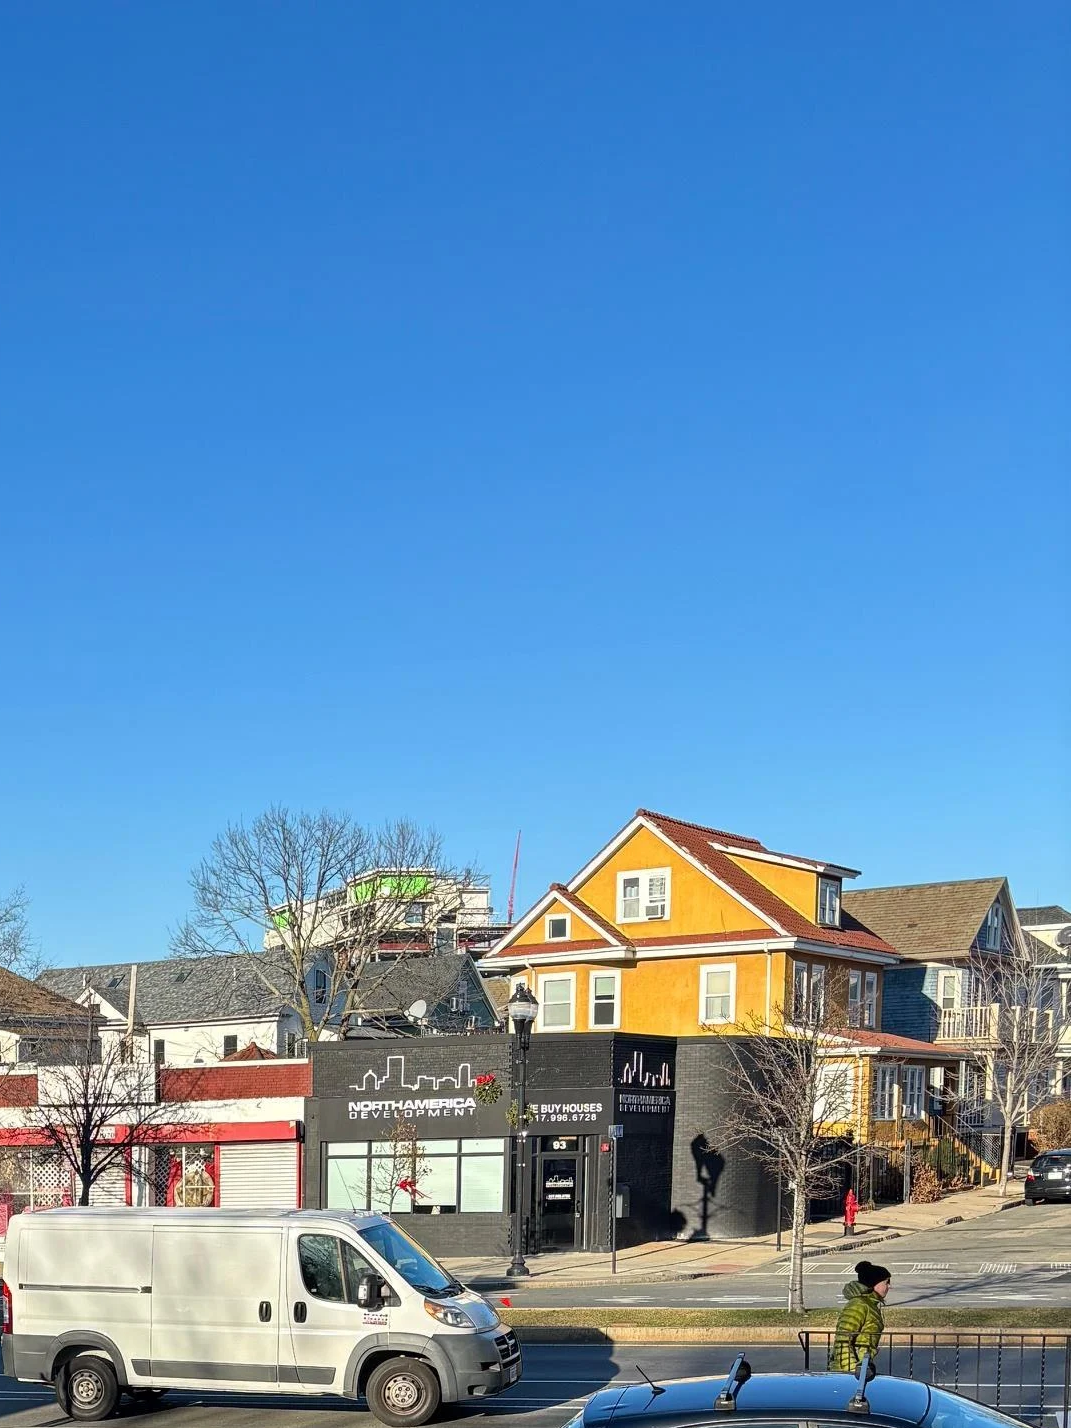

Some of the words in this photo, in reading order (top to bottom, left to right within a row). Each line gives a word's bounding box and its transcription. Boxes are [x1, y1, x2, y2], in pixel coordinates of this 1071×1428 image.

[348, 1098, 476, 1111] NORTHAMERICA
[540, 1104, 560, 1113] BUY
[562, 1103, 603, 1113] HOUSES
[349, 1108, 475, 1119] DEVELOPMENT
[552, 1140, 567, 1150] 93
